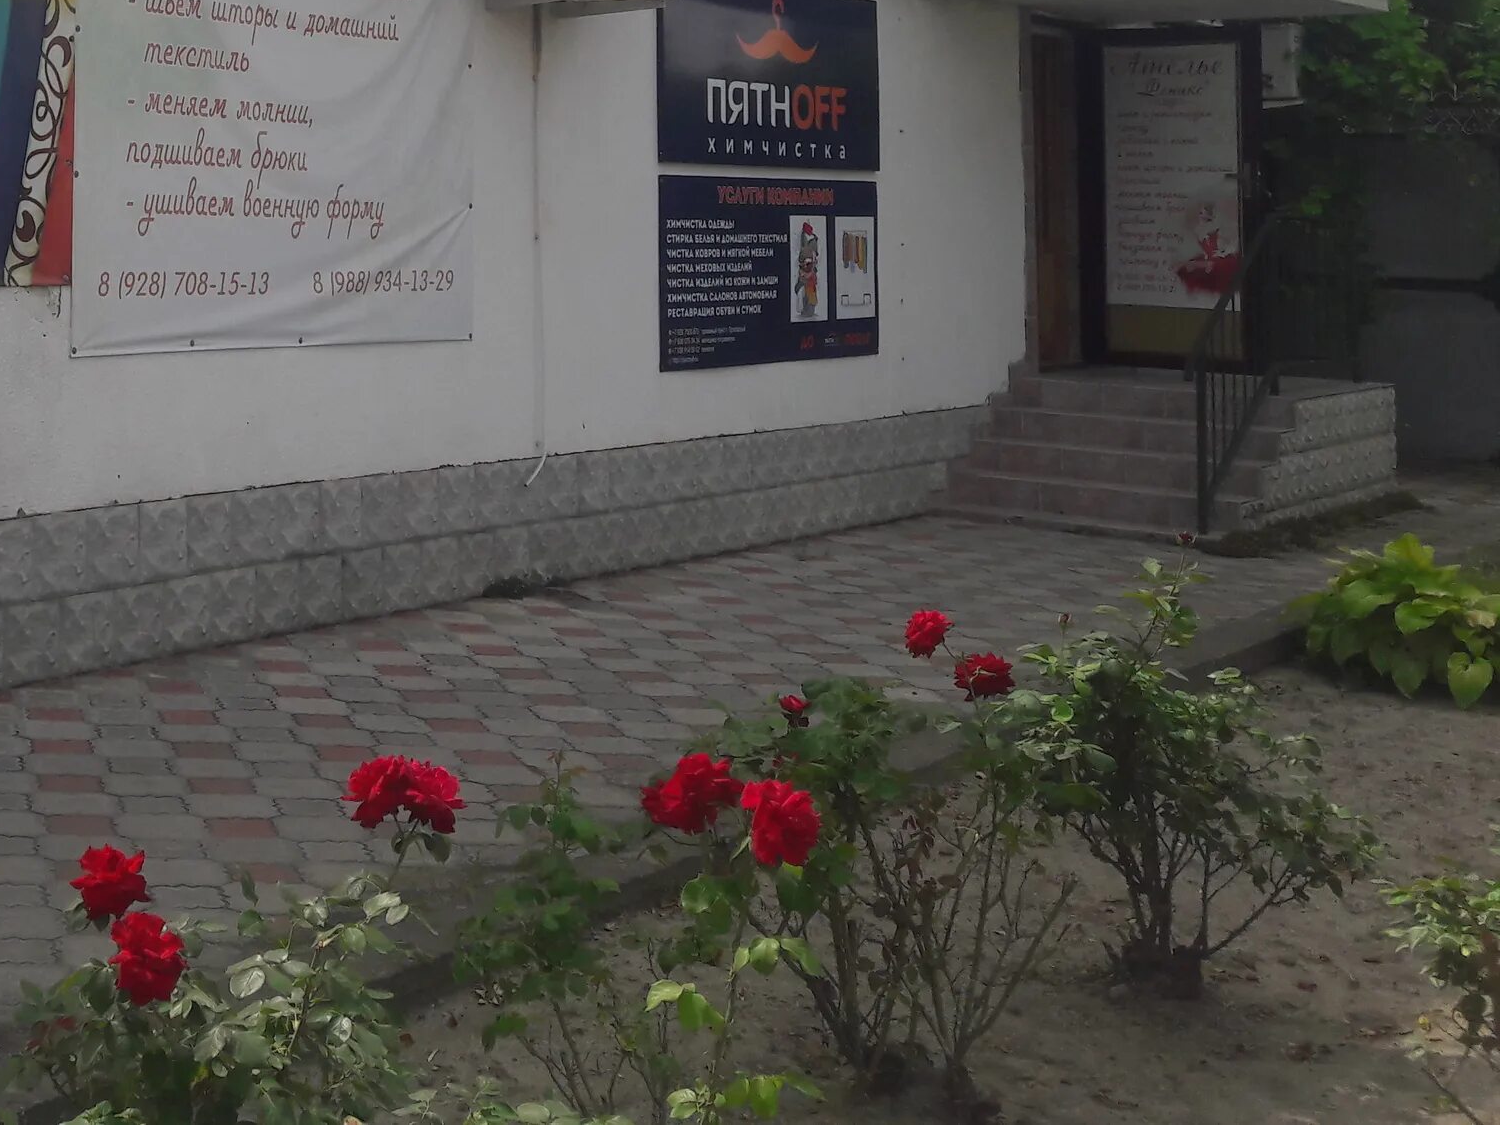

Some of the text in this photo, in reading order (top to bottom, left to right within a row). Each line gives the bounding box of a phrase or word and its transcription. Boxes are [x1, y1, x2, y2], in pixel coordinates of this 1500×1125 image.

[211, 1, 279, 45] шторы
[286, 11, 297, 31] и
[303, 11, 400, 41] домашний
[143, 40, 250, 73] текстиль
[144, 91, 313, 128] меняем молнии,
[126, 127, 308, 189] подшиваем брюки
[137, 177, 384, 239] ушиваем военную форму
[666, 219, 735, 229] ХИМЧИСТКА ОДЕЖДЫ
[667, 234, 693, 243] СТИРКА
[695, 234, 715, 243] БЕЛЬЯ
[758, 234, 788, 243] ТЕКСТИЛЯ
[667, 249, 694, 259] ЧИСТКА
[695, 249, 720, 258] КОВРОВ
[667, 264, 694, 273] ЧИСТКА
[98, 271, 270, 299] 8 (928) 708-15-13
[312, 269, 454, 296] 8 (988) 934-13-29
[667, 278, 694, 288] ЧИСТКА
[667, 293, 708, 303] ХИМЧИСТКА
[667, 307, 715, 318] РЕСТАВРАЦИЯ
